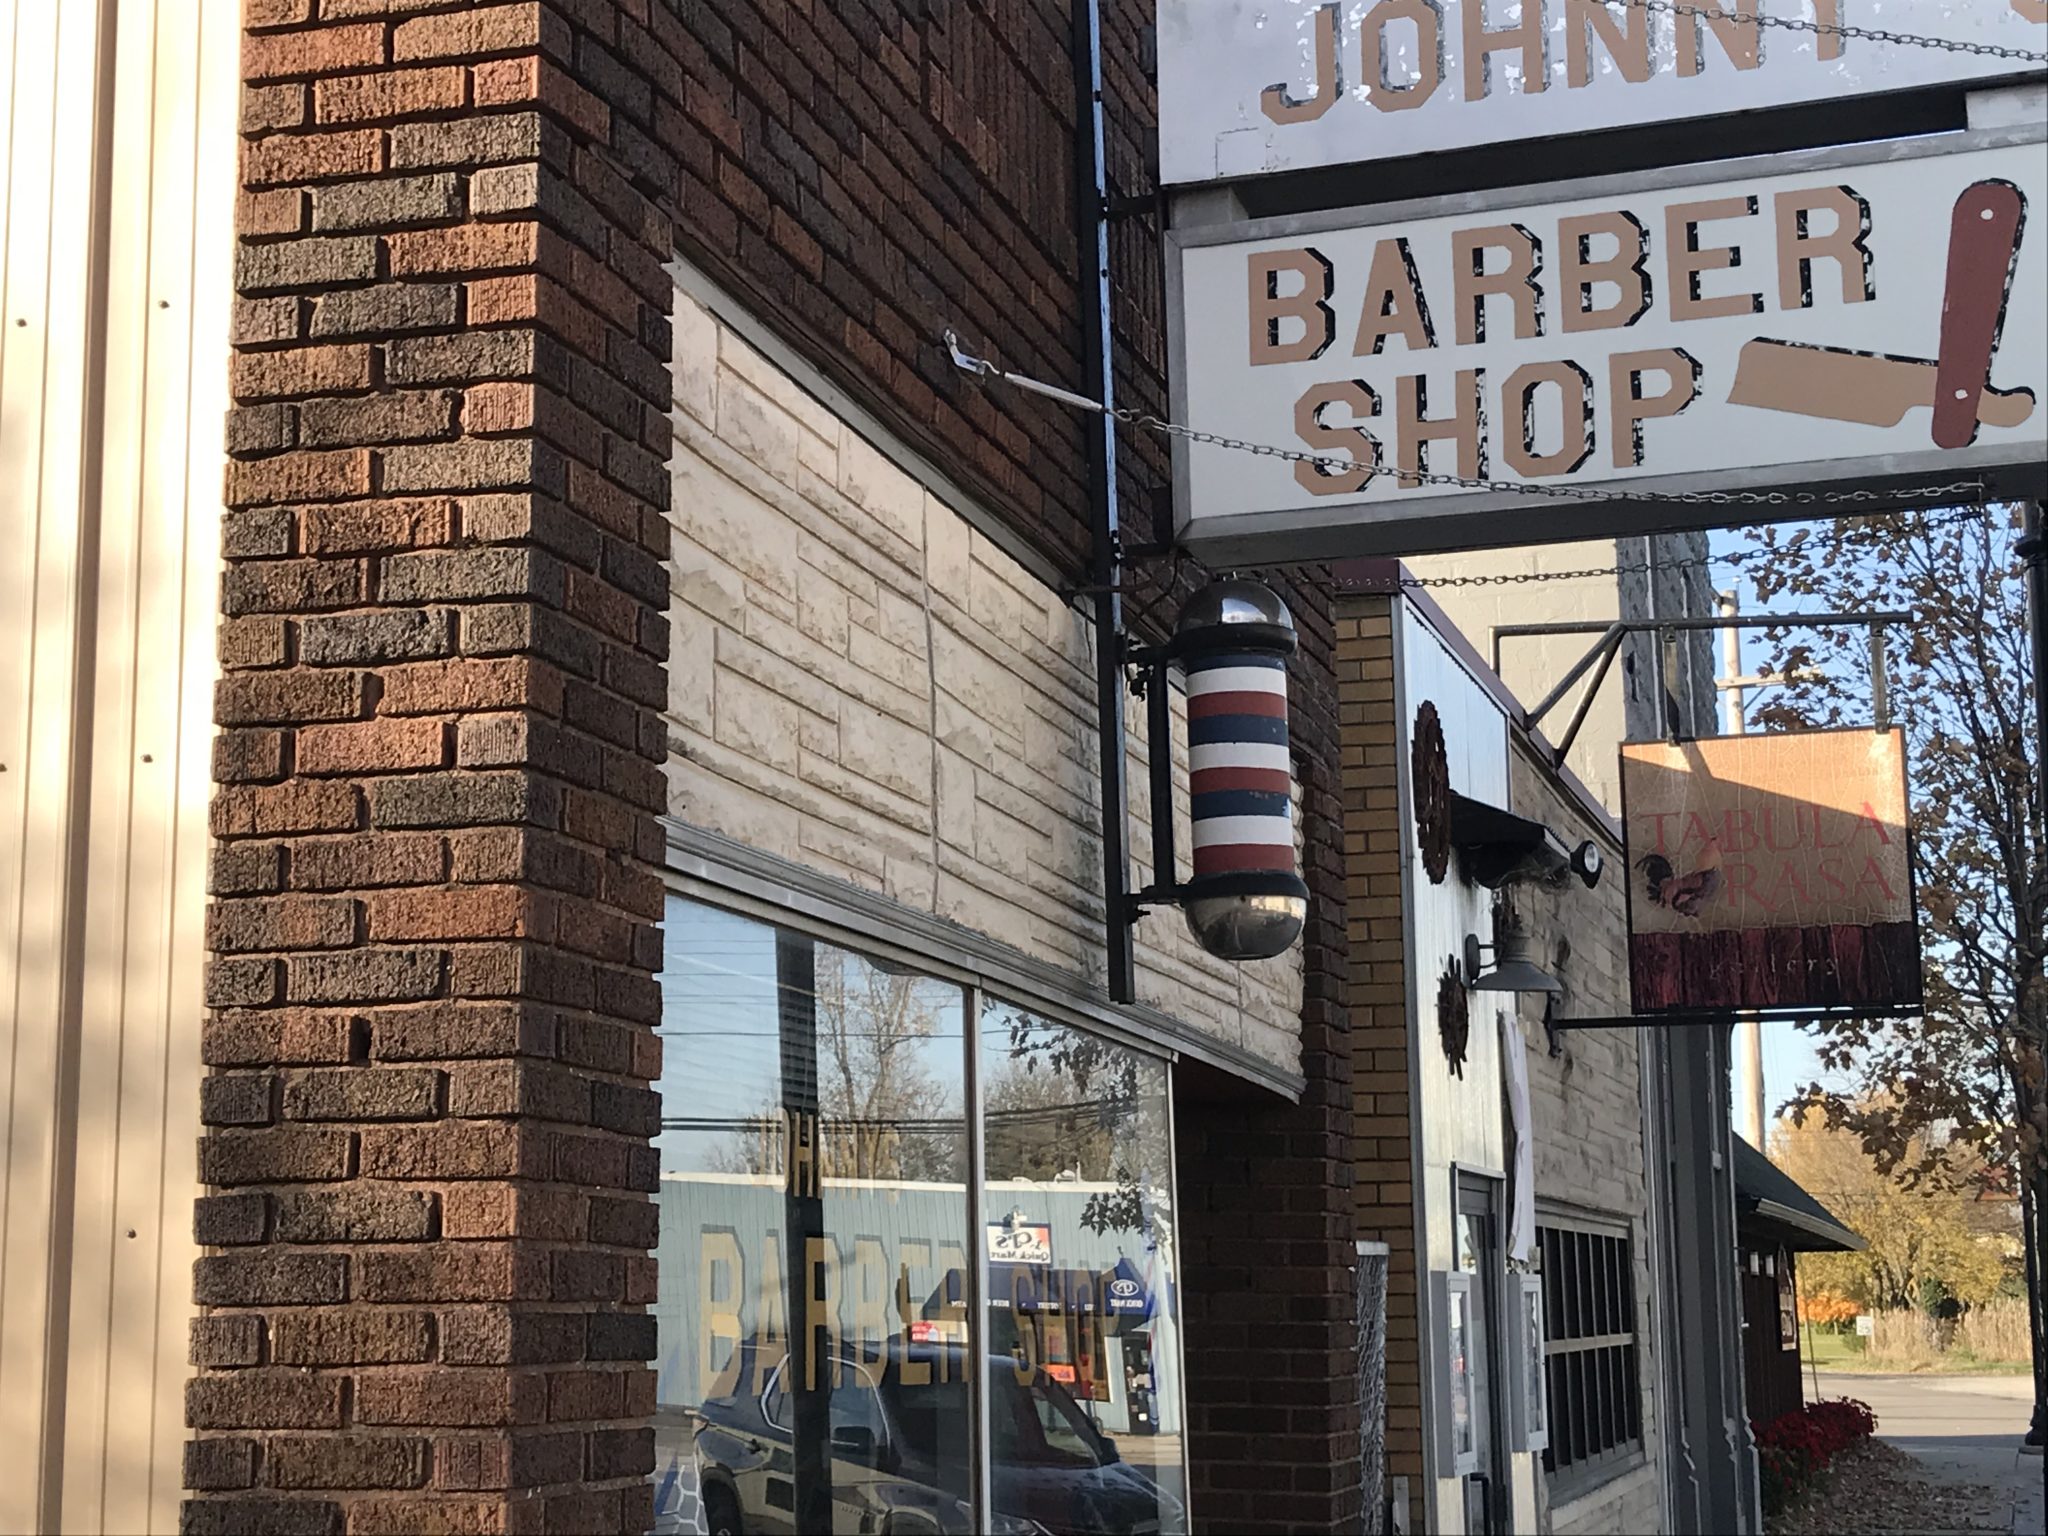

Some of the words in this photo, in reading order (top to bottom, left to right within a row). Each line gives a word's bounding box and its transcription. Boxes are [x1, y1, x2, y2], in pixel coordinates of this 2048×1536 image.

[1248, 184, 1876, 366] BARBER
[1294, 346, 1703, 496] SHOP
[1640, 801, 1891, 854] TABULA
[1723, 856, 1897, 912] RASA
[700, 1224, 971, 1397] BARBER
